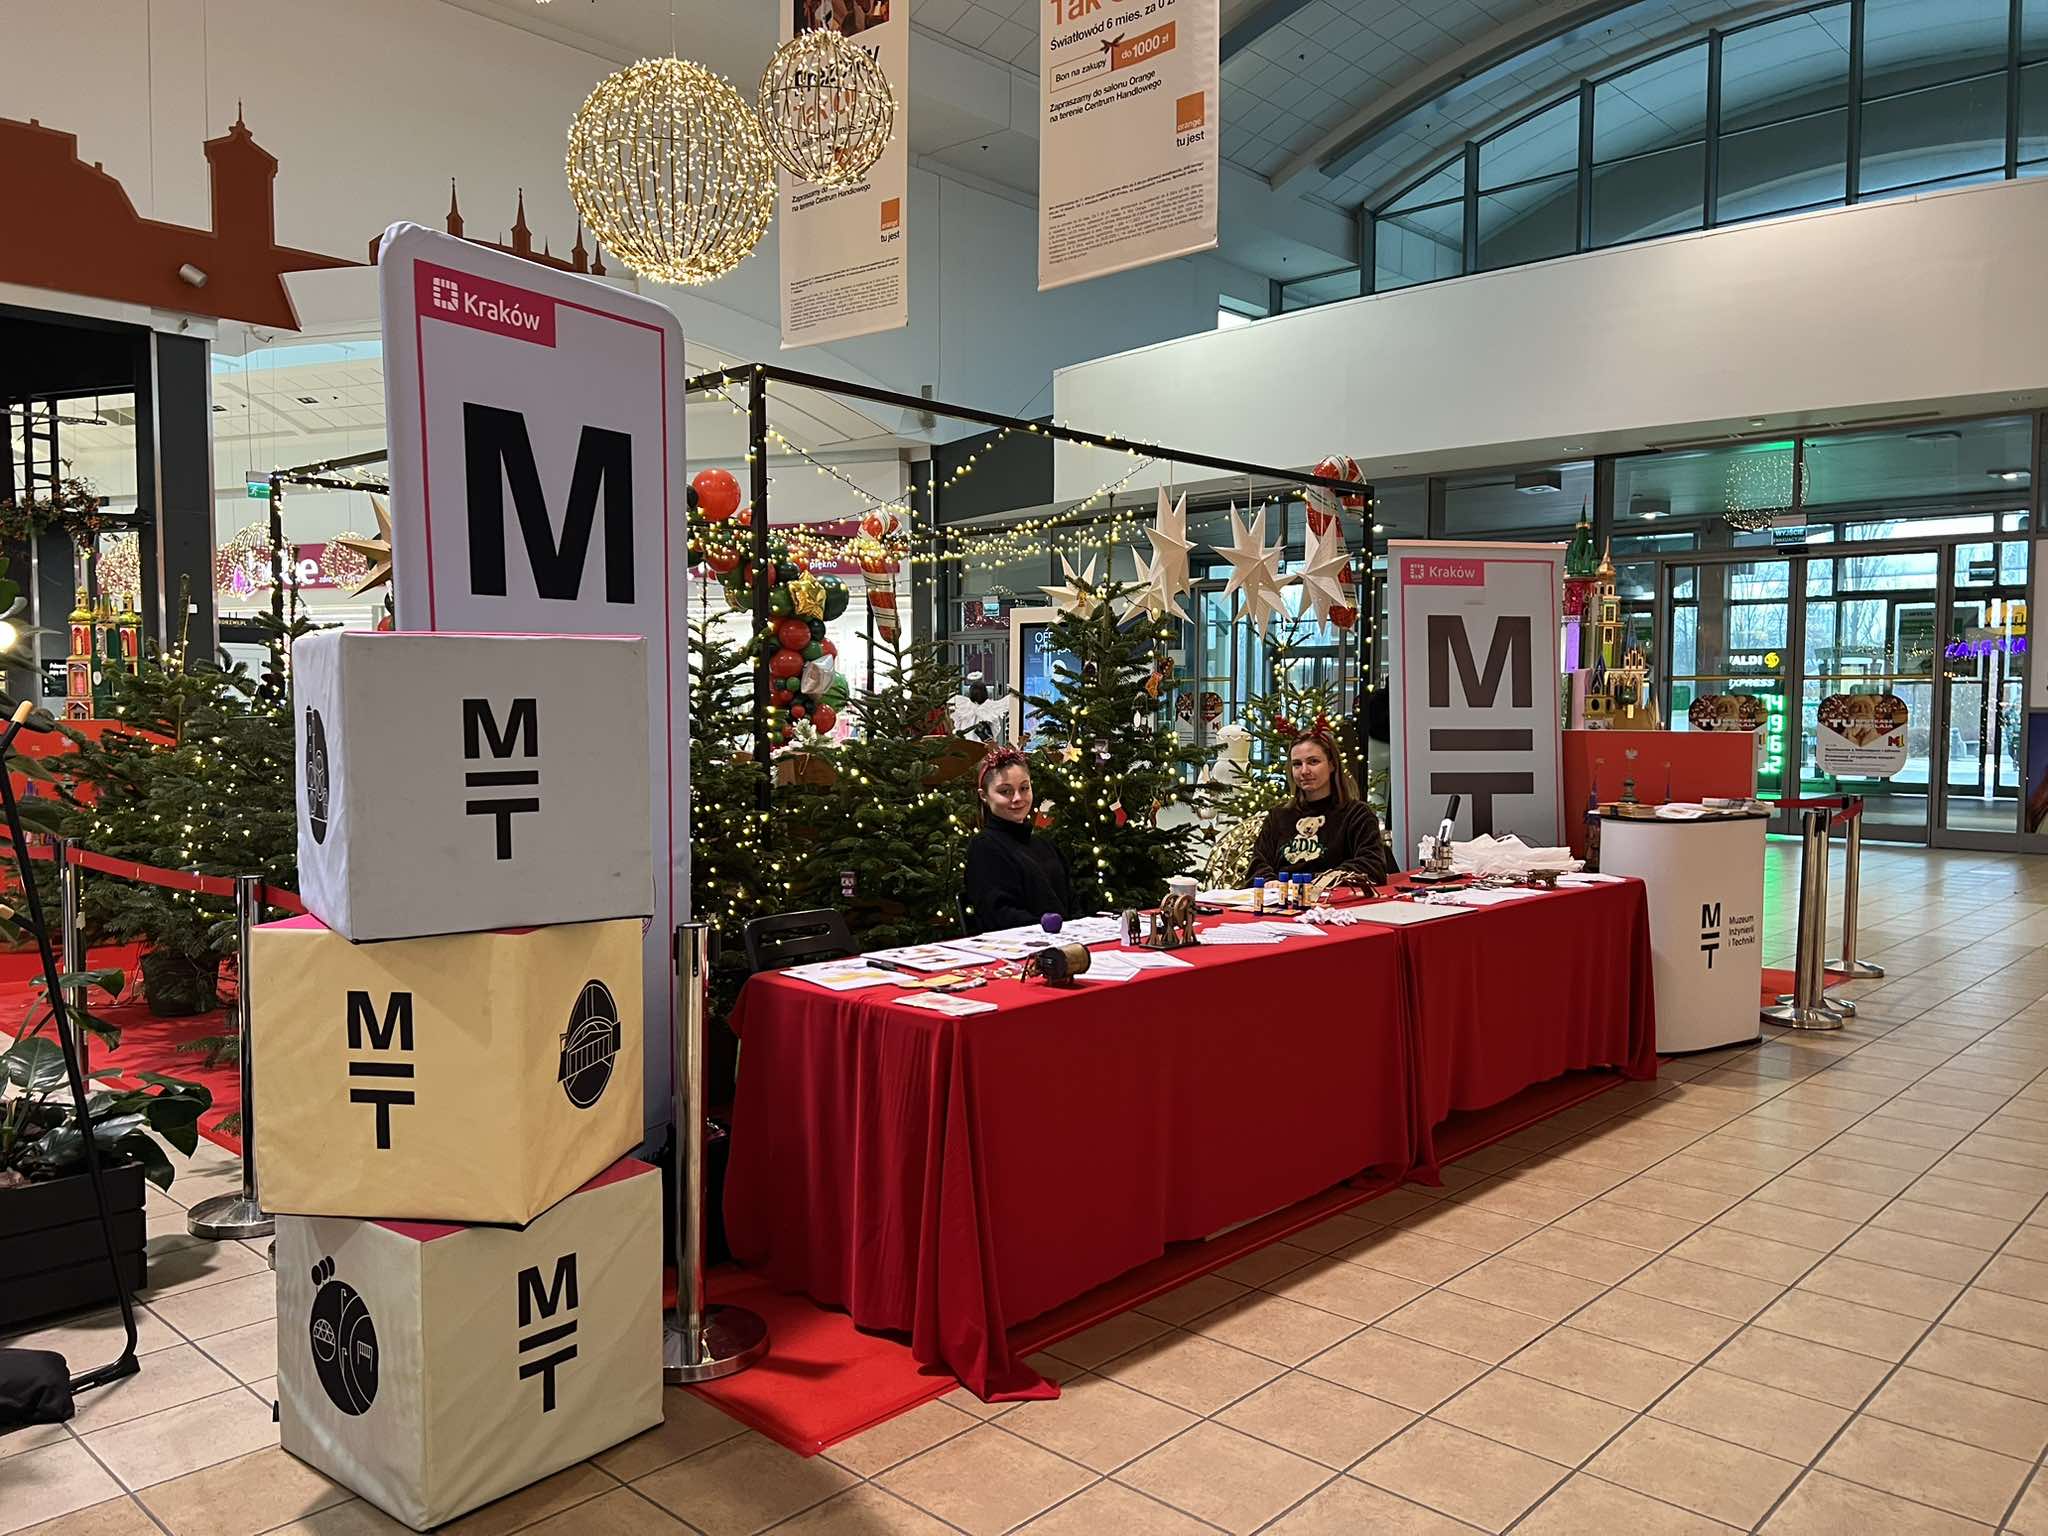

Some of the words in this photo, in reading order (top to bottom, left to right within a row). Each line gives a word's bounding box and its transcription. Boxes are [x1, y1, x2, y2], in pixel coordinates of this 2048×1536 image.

[1050, 20, 1105, 51] Światłowód
[1106, 17, 1113, 29] 6
[1114, 10, 1143, 26] mies.
[1144, 2, 1156, 15] za
[1055, 72, 1070, 83] Bon
[1070, 67, 1080, 77] na
[1081, 58, 1107, 74] zakupy
[1121, 49, 1133, 60] do
[1132, 34, 1160, 58] 1000
[1049, 91, 1092, 113] Zapraszamy
[1092, 88, 1103, 98] do
[1103, 80, 1128, 95] salonu
[1129, 69, 1156, 86] Orange
[1049, 114, 1059, 124] na
[1059, 105, 1084, 120] terenie
[1084, 94, 1115, 112] Centrum
[1116, 78, 1162, 101] Handlowego
[1176, 137, 1186, 147] tu
[1186, 130, 1205, 147] jest
[464, 292, 540, 331] Kraków
[463, 402, 635, 605] M
[1429, 565, 1476, 580] Kraków
[1828, 718, 1855, 729] TU
[1728, 915, 1755, 925] Muzeum
